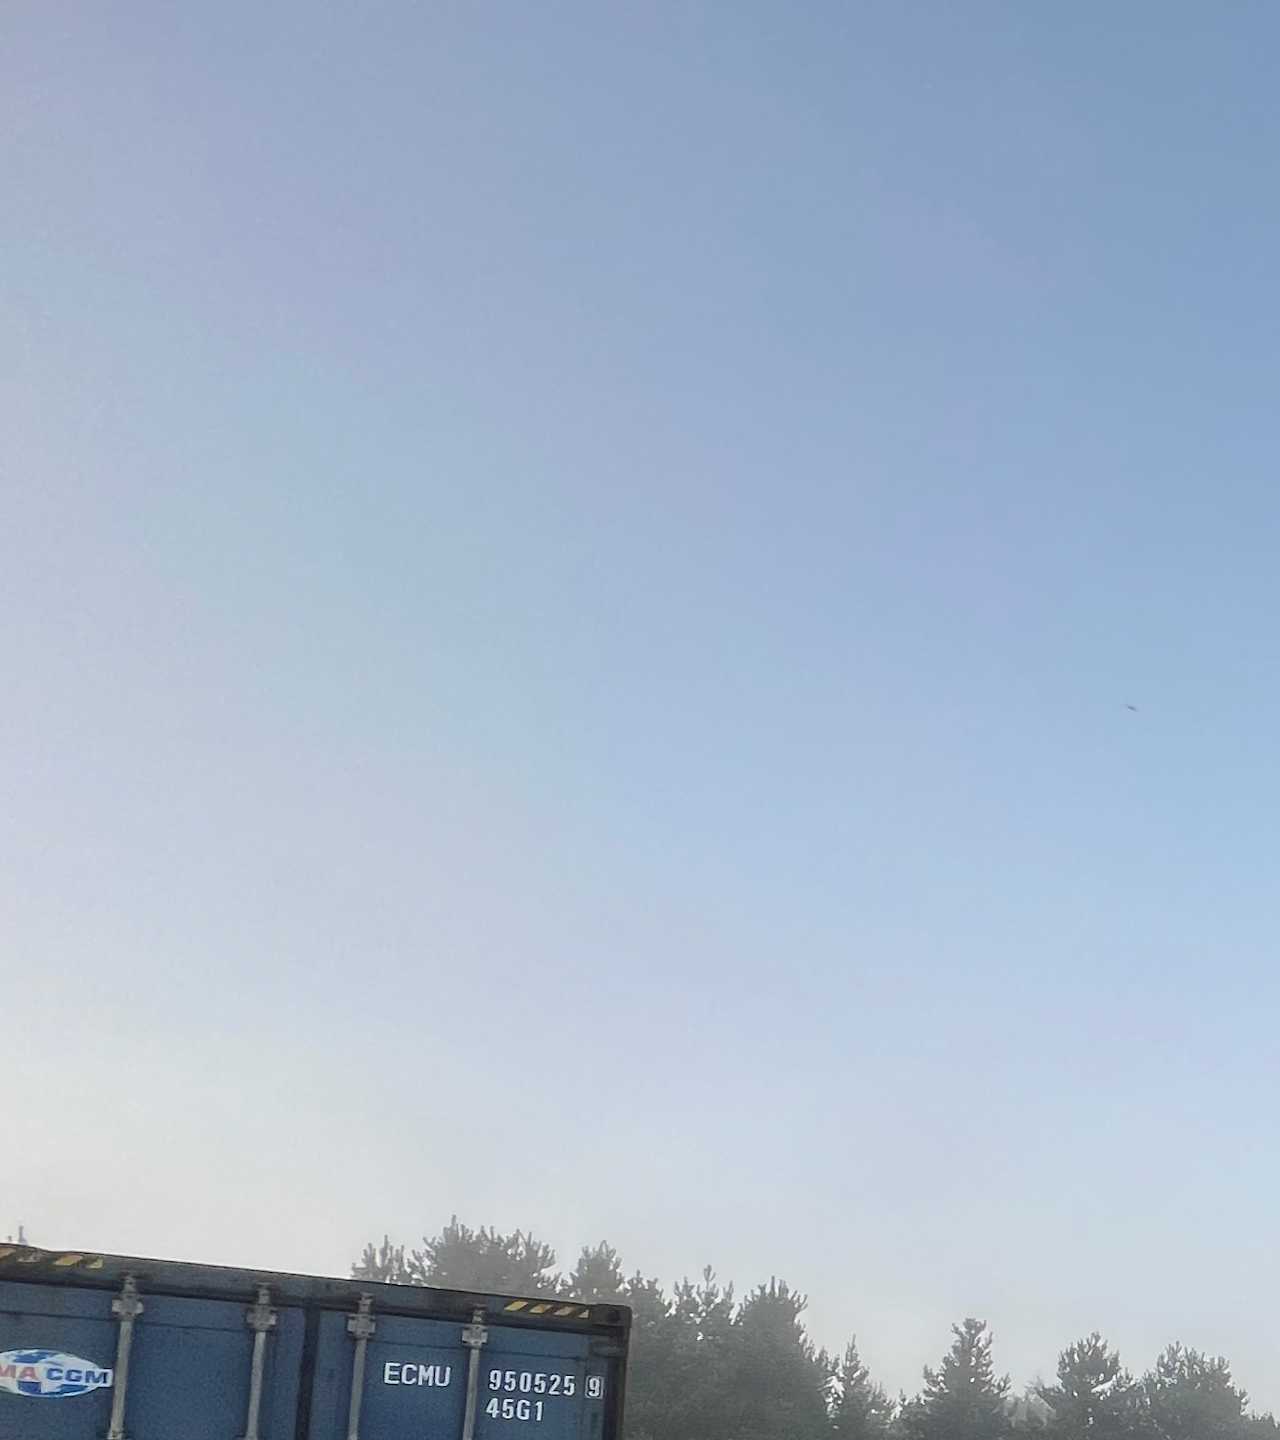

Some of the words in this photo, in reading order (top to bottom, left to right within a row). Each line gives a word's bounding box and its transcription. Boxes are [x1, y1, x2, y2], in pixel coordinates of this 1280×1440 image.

[47, 1368, 109, 1384] CGM
[384, 1362, 451, 1387] ECMU
[489, 1370, 575, 1396] 950525
[588, 1376, 602, 1398] 9
[486, 1398, 543, 1421] 45G1
